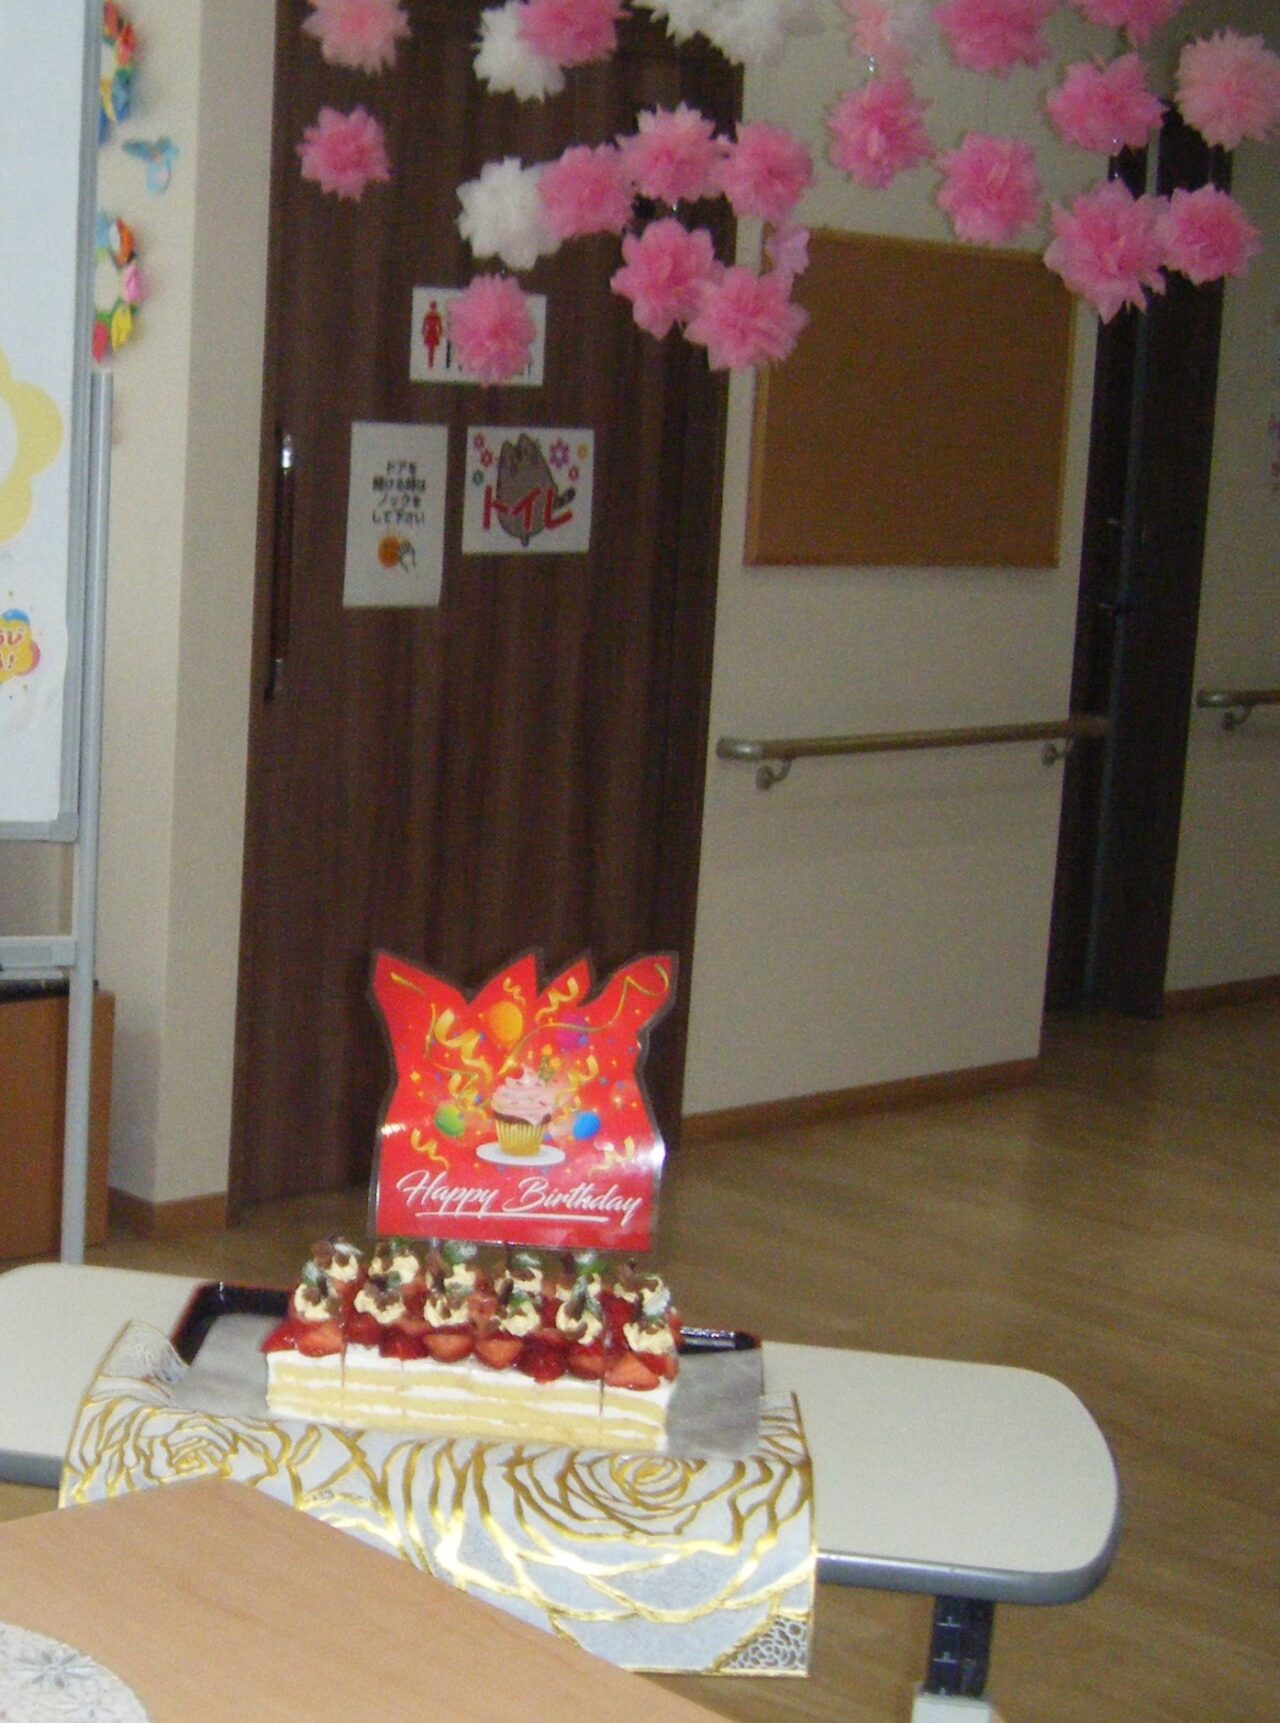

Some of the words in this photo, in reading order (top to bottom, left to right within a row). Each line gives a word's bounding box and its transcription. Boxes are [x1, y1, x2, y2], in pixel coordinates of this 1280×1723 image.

[482, 485, 573, 530] トイレ
[396, 1168, 499, 1220] Happy
[502, 1176, 643, 1227] Birthday
